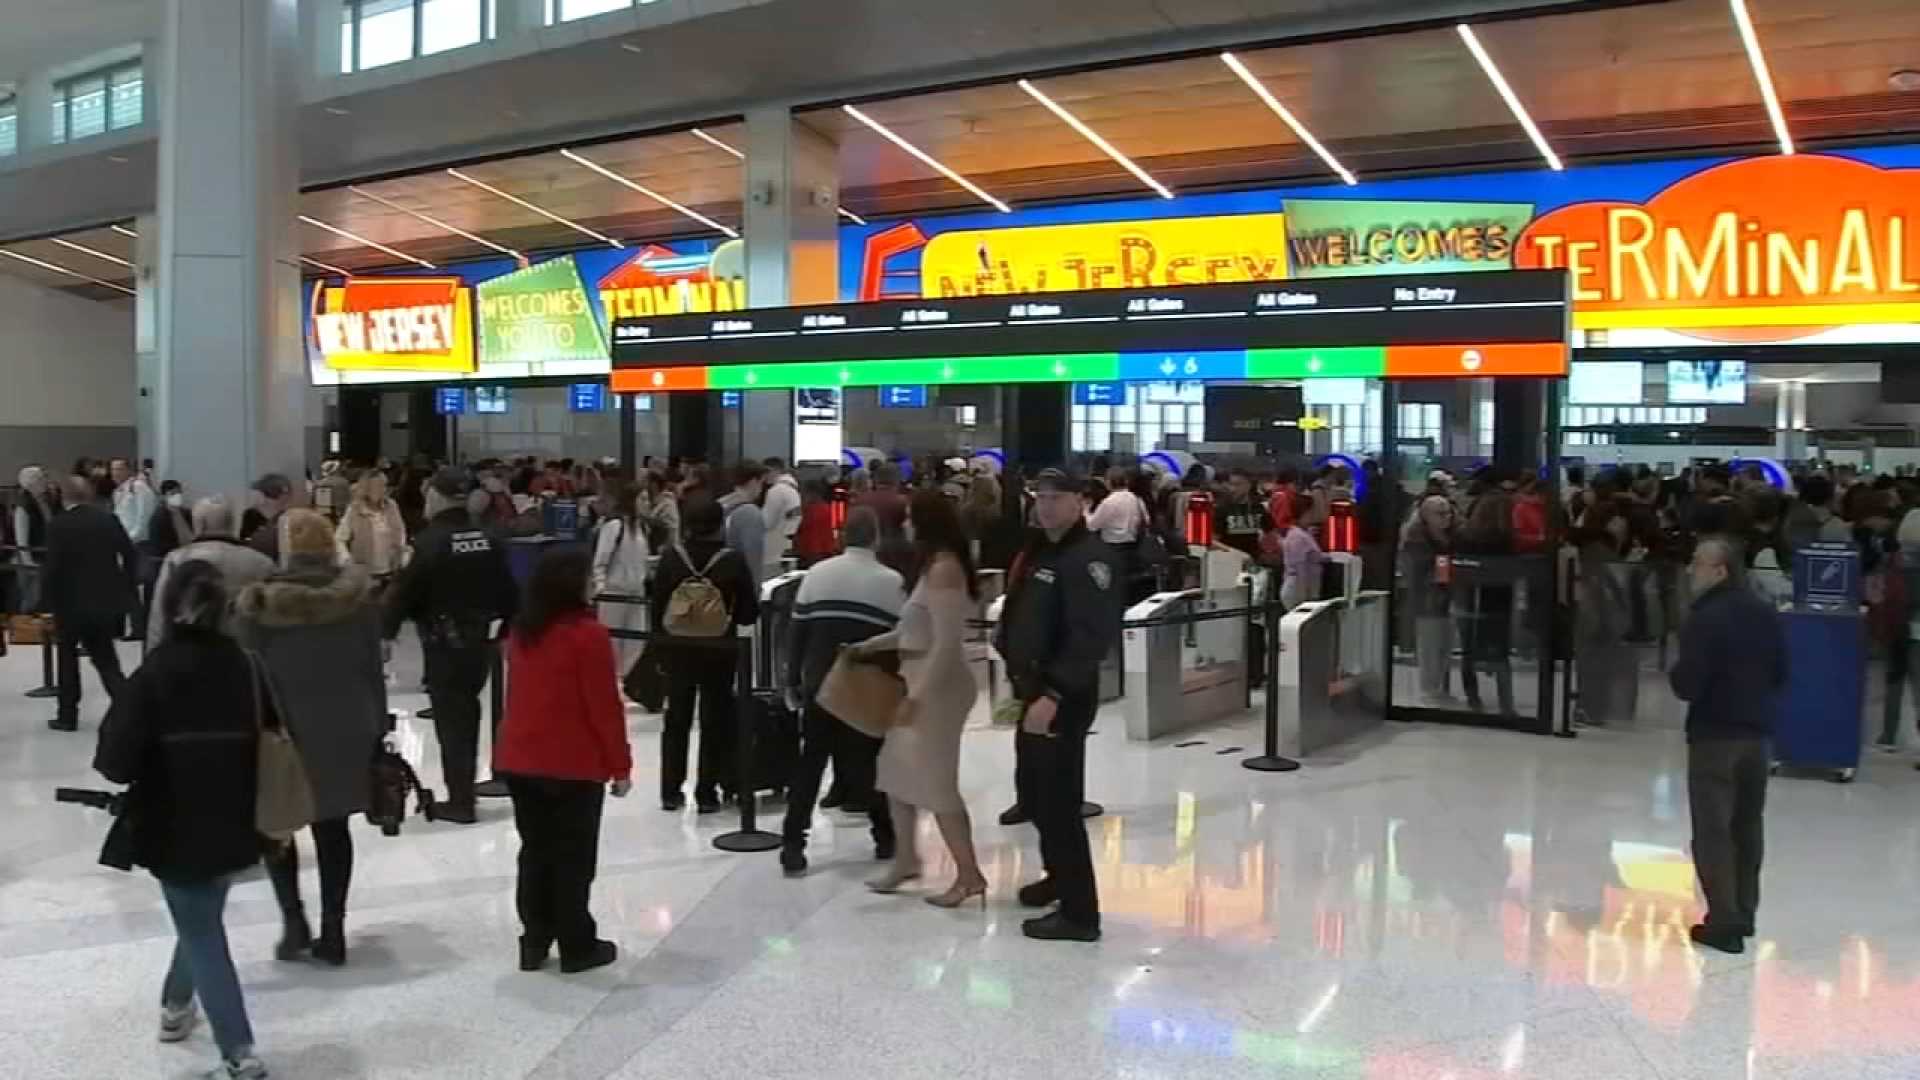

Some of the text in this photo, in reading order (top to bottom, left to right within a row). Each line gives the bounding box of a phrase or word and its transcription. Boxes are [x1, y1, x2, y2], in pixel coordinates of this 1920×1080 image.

[1289, 222, 1511, 269] WELCOMES
[481, 288, 585, 321] WELCOMES
[1393, 287, 1458, 303] No Entry
[317, 303, 454, 355] NEW JERSEY
[1183, 356, 1198, 375] 6
[452, 539, 491, 553] POLICE
